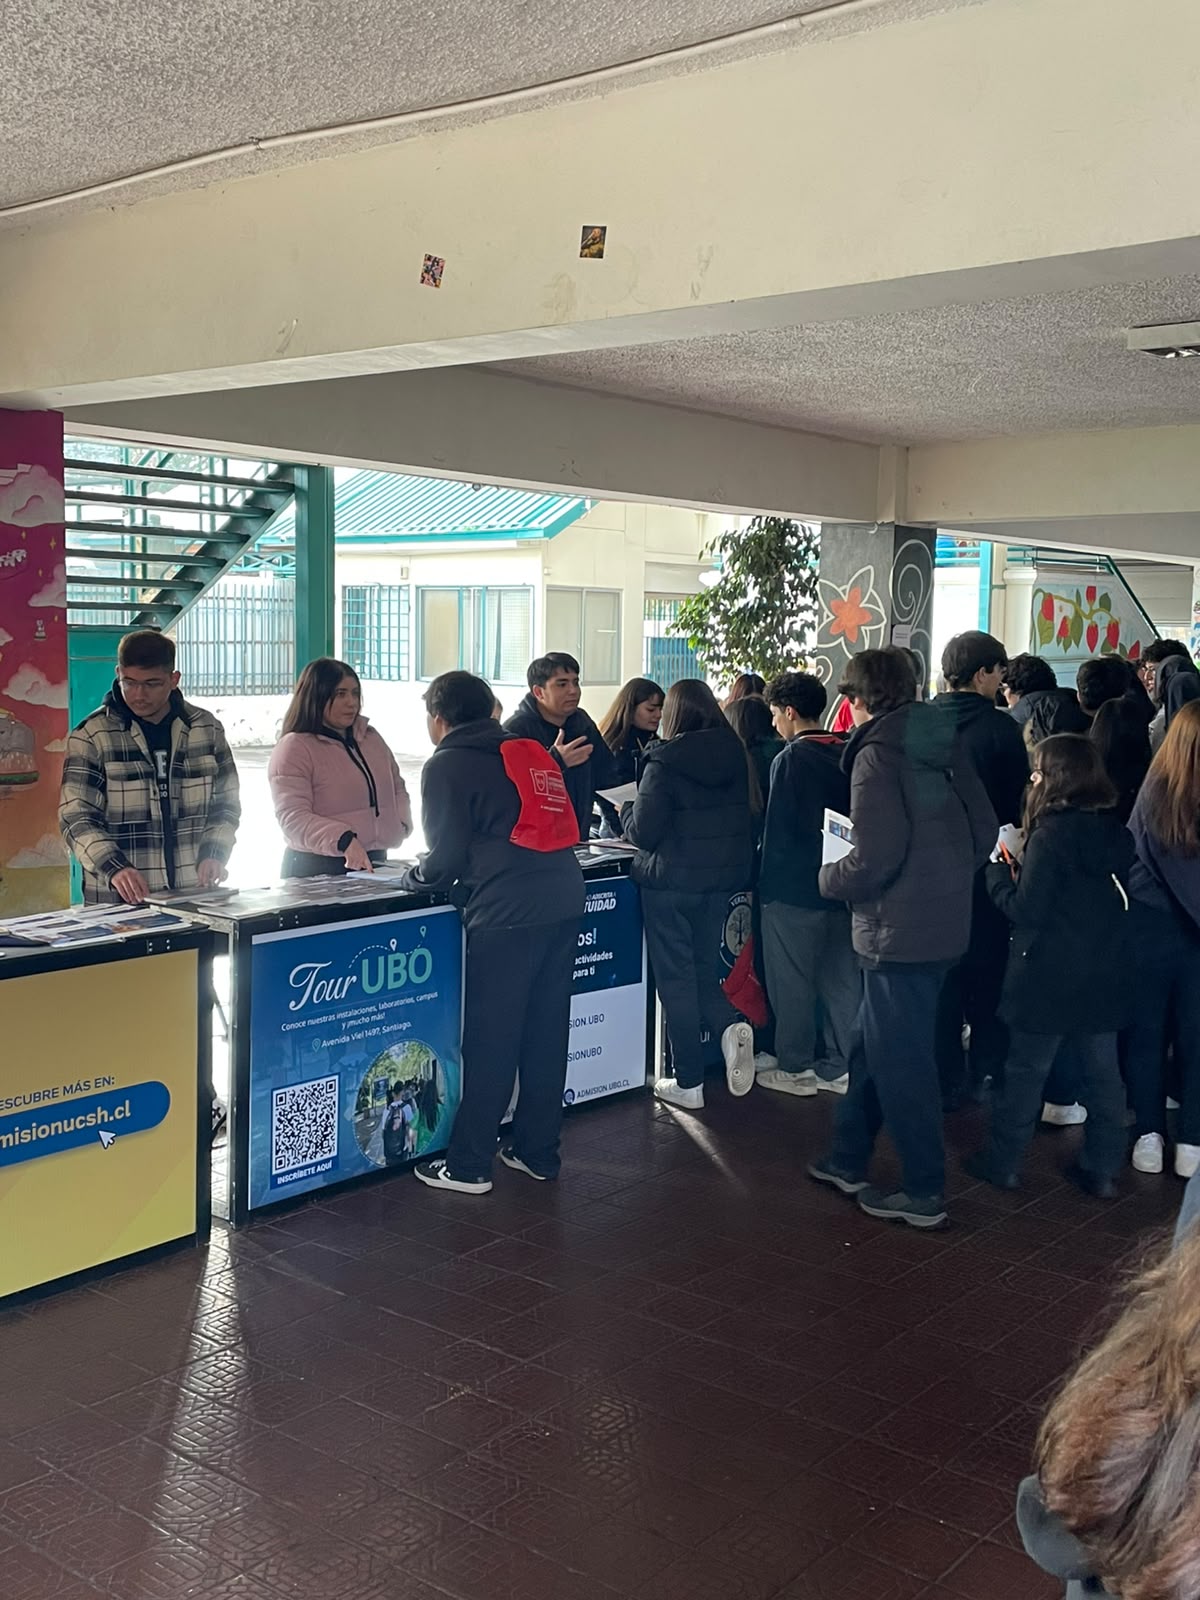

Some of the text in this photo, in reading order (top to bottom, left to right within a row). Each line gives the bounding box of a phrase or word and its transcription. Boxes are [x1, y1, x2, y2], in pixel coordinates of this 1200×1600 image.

[289, 947, 433, 1011] Tour UBO
[572, 965, 596, 980] para ti
[281, 991, 438, 1032] Conoce nuestras instalaciones, laboratorios, campus
[370, 1012, 386, 1022] más!
[321, 1035, 350, 1048] Avenida
[350, 1031, 364, 1041] Viel
[62, 1080, 91, 1097] MÁS
[94, 1075, 115, 1089] EN:
